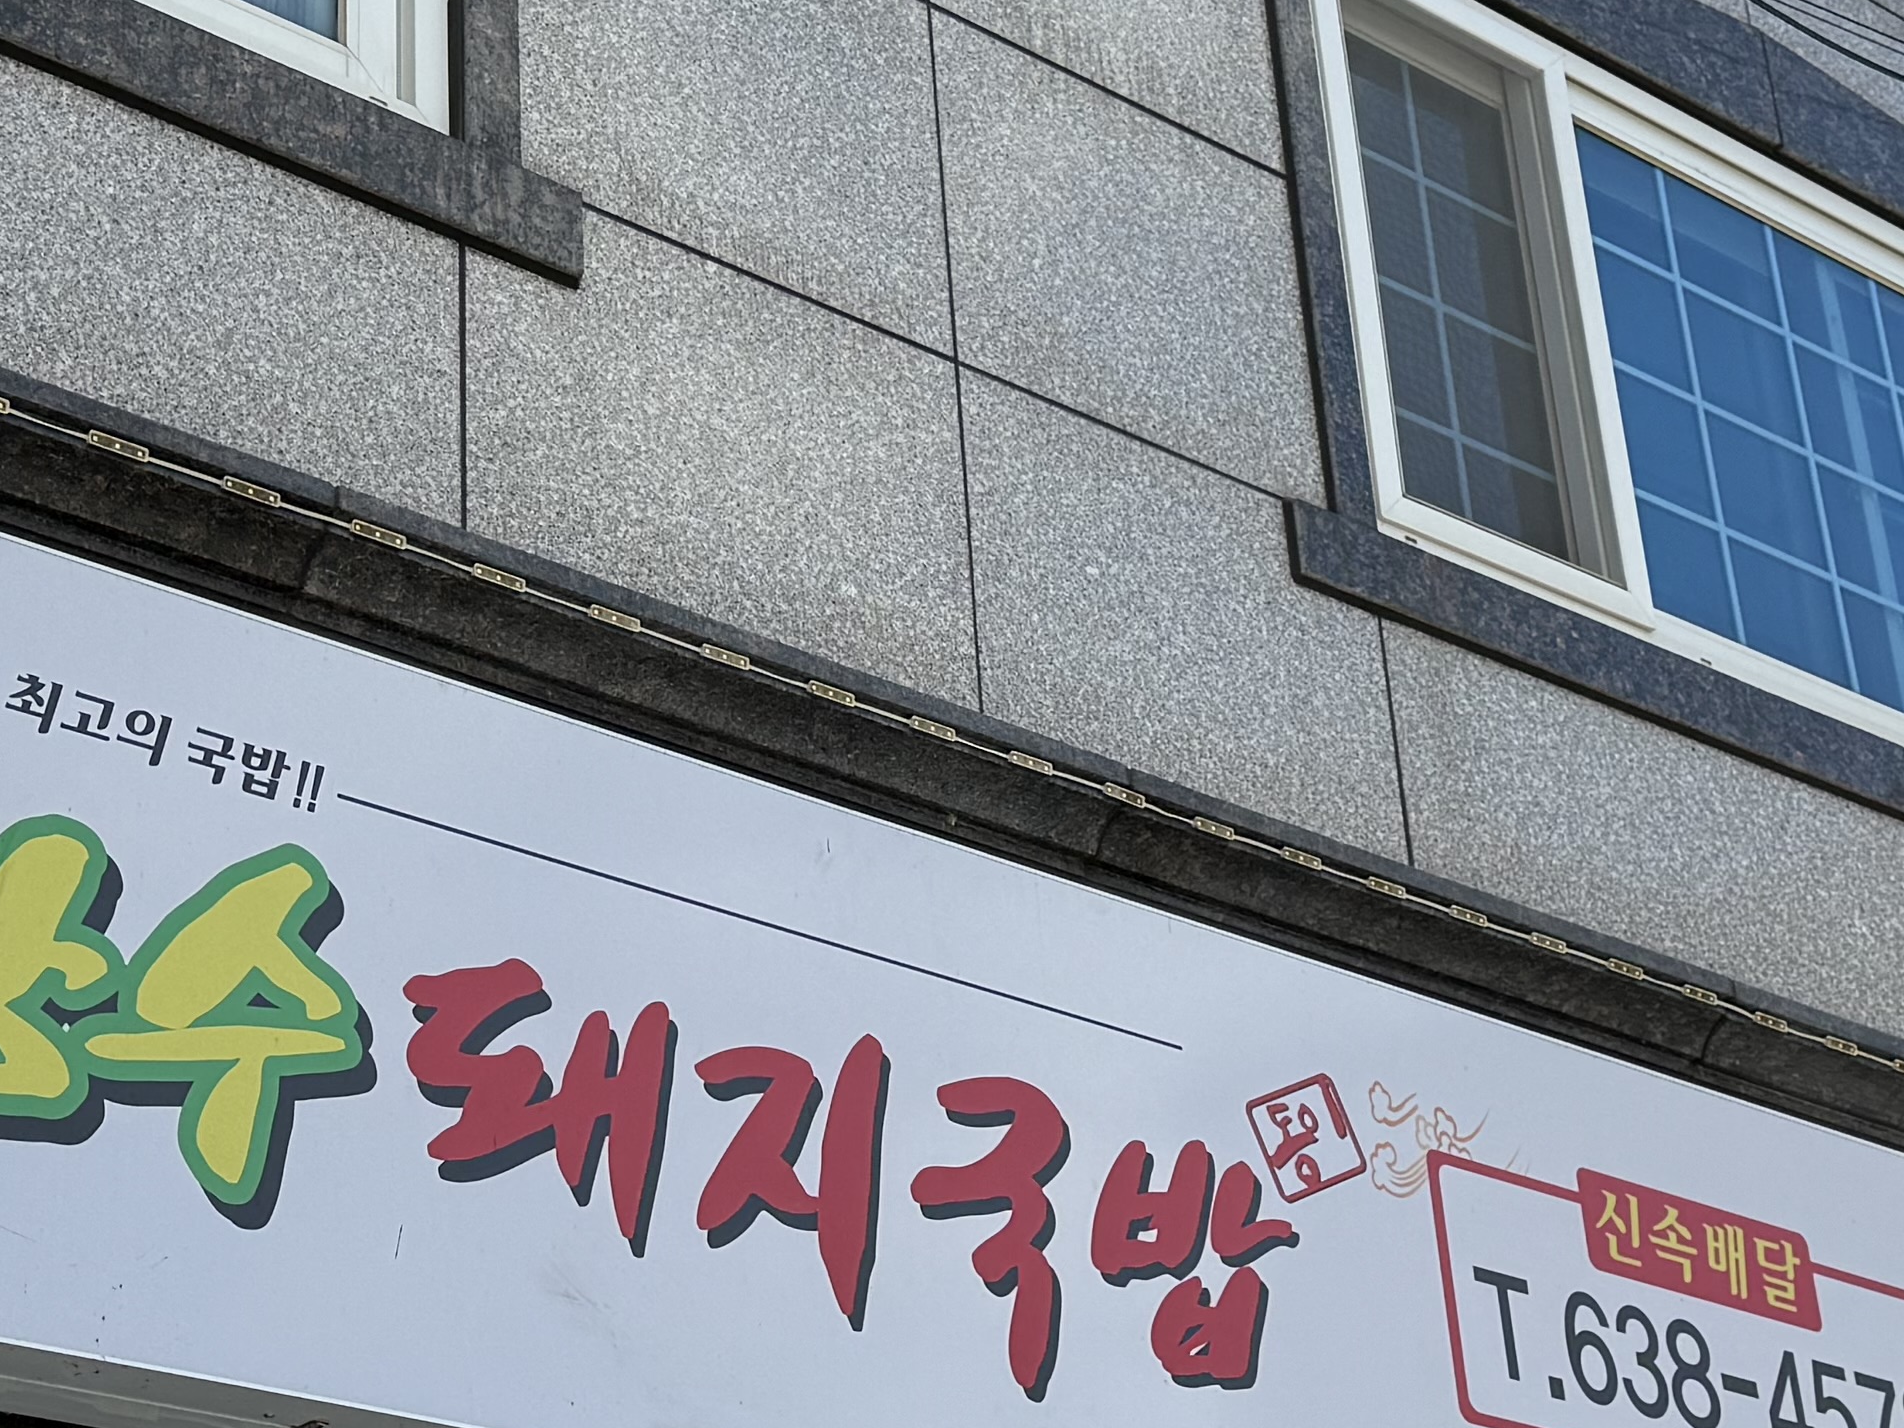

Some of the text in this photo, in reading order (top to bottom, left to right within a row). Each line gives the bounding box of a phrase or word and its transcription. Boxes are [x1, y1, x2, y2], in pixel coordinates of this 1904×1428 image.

[4, 672, 173, 767] 최고의
[186, 725, 326, 814] 국밥!!
[402, 957, 1300, 1402] 돼지국밥
[1594, 1188, 1803, 1313] 신속배달
